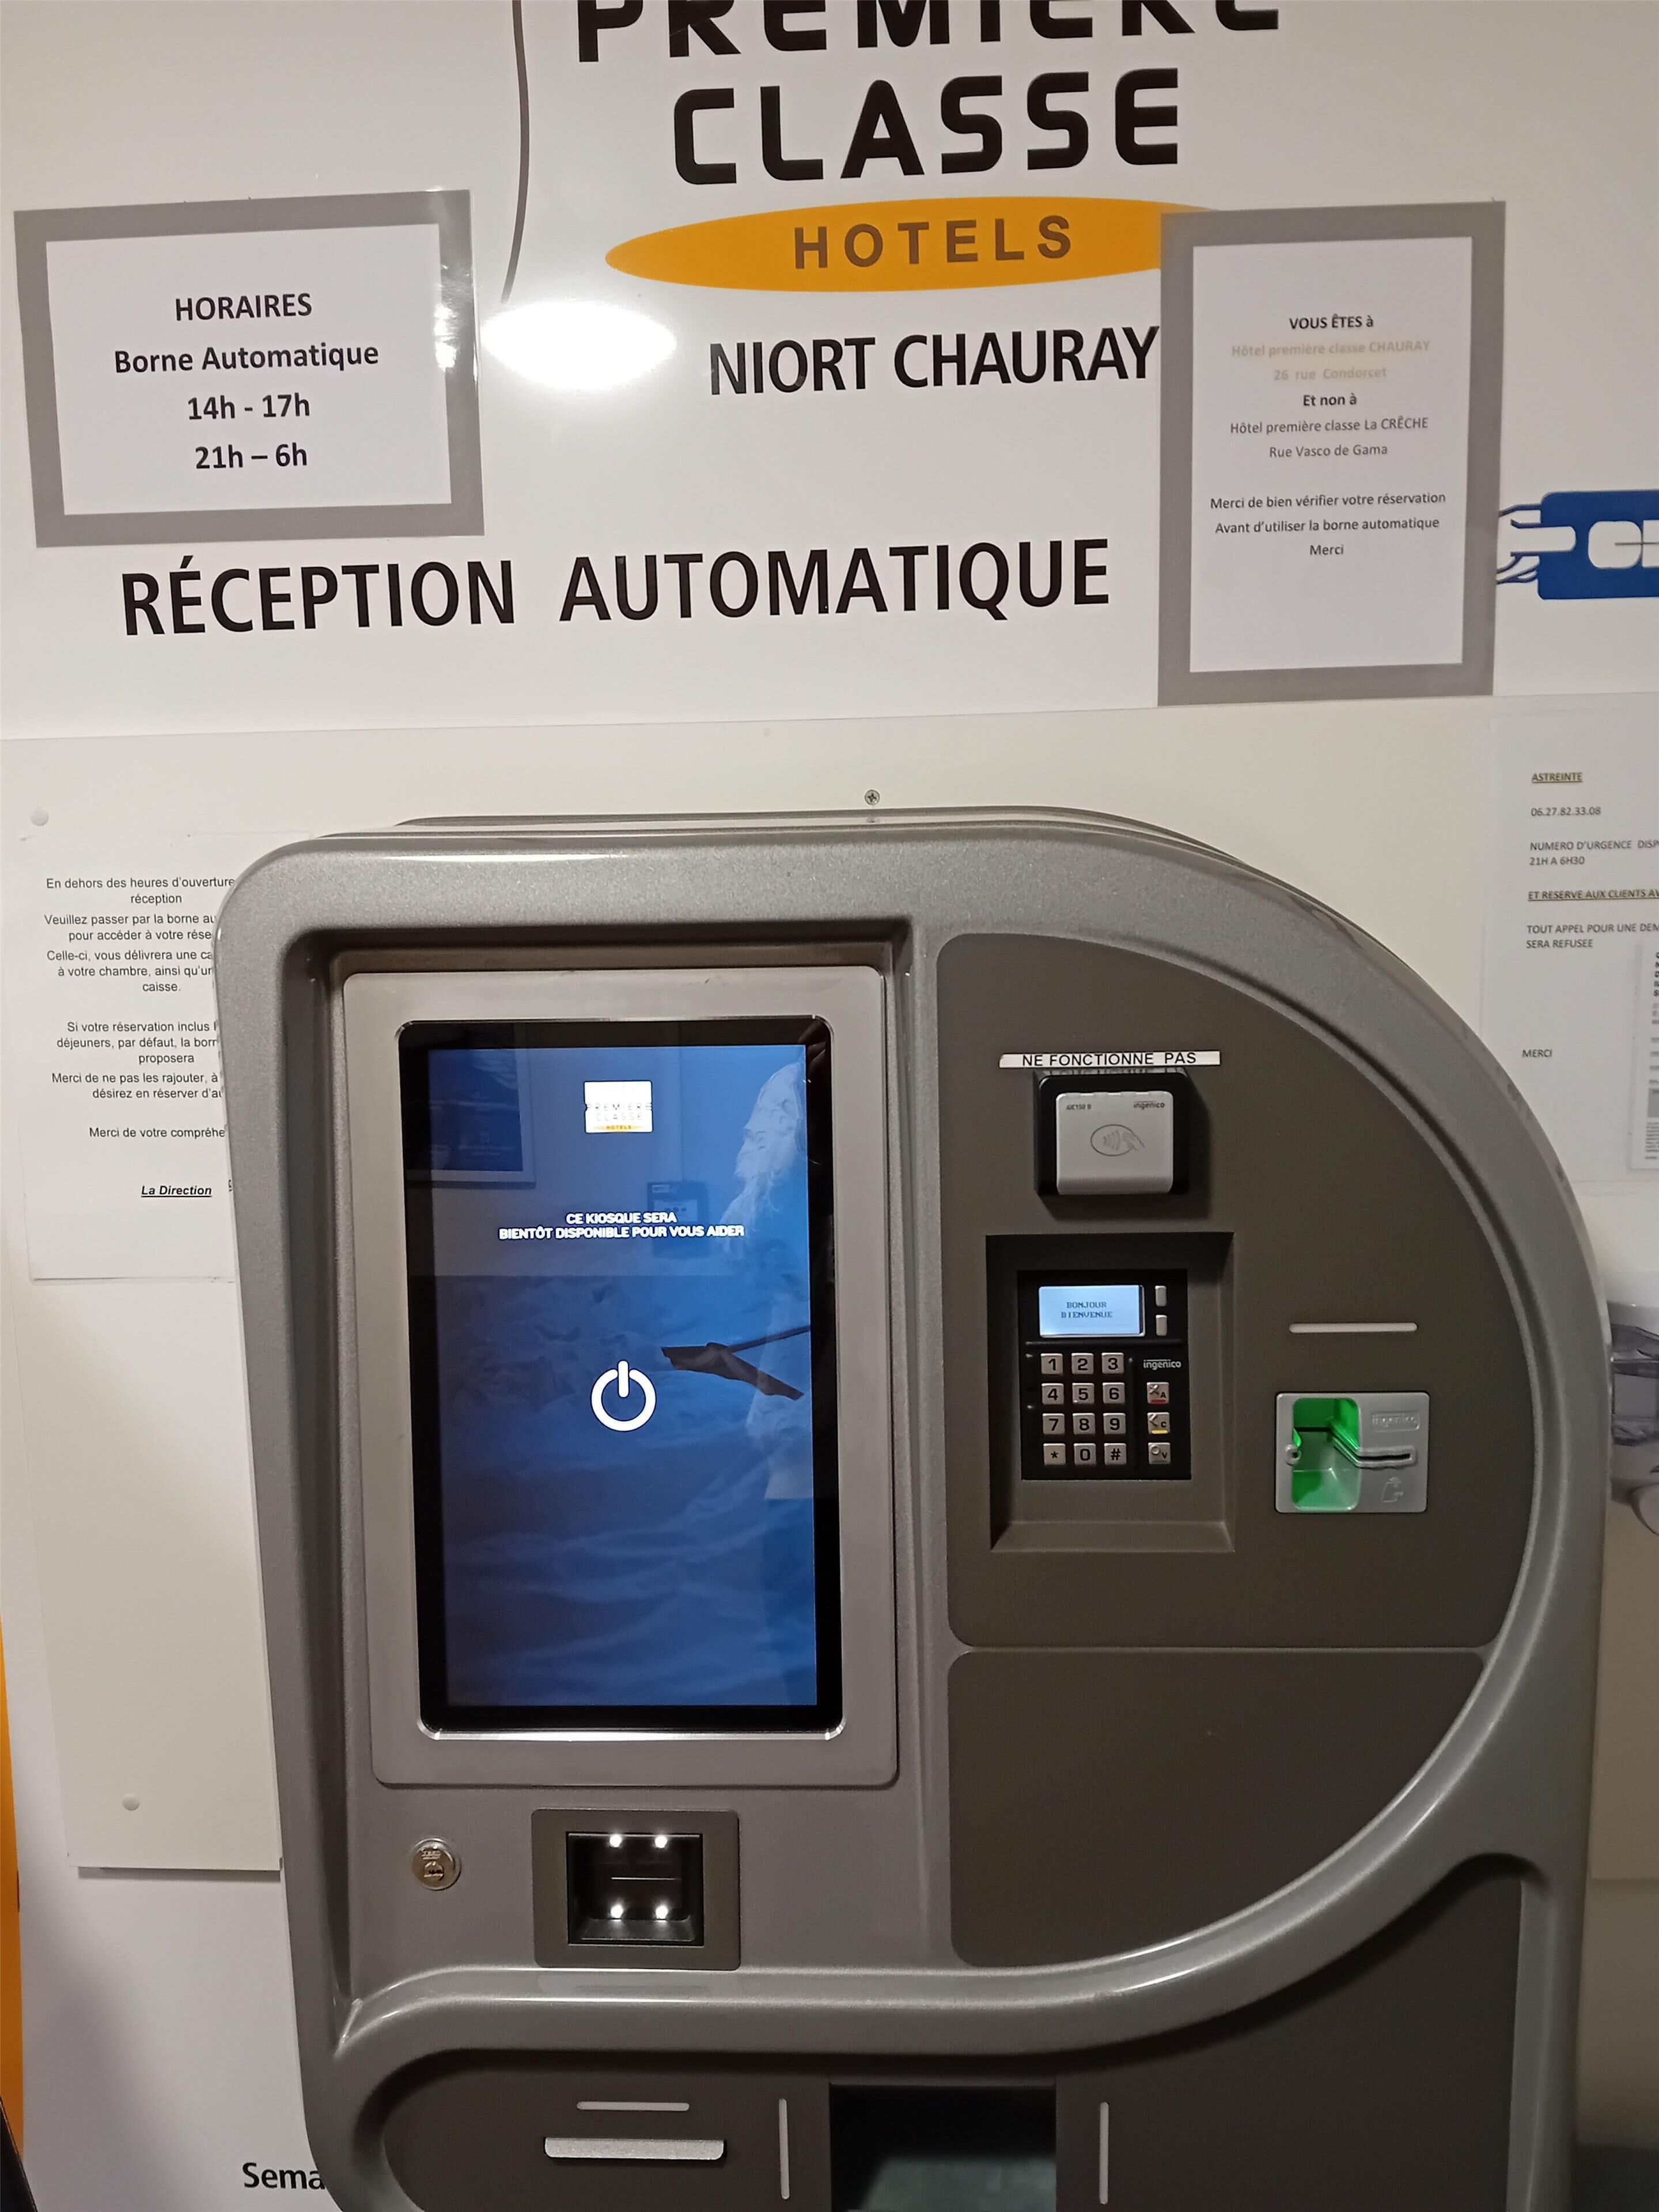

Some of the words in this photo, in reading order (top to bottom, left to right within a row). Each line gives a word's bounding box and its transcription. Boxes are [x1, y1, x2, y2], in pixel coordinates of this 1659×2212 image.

[674, 68, 1179, 184] CLASSE
[794, 215, 1071, 270] HOTELS
[176, 293, 312, 321] HORAIRES
[1289, 317, 1327, 330] VOUS
[1331, 314, 1362, 328] ÊTES
[1366, 315, 1374, 328] à
[1232, 344, 1265, 357] Hôtel
[1268, 343, 1325, 358] première
[1329, 342, 1365, 354] classe
[1369, 340, 1430, 353] CHAURAY
[115, 350, 193, 373] Borne
[202, 343, 379, 371] Automatique
[709, 337, 875, 396] NIORT
[894, 325, 1160, 388] CHAURAY
[1274, 369, 1288, 380] 26
[1296, 370, 1316, 380] rue
[1323, 368, 1387, 380] Condorcet
[1303, 395, 1316, 406] Et
[1320, 395, 1345, 405] non
[1349, 393, 1357, 404] à
[188, 396, 236, 421] 14h
[263, 393, 310, 418] 17h
[1230, 421, 1263, 434] Hôtel
[1267, 421, 1321, 435] première
[1325, 419, 1361, 430] classe
[1365, 419, 1377, 430] La
[1381, 416, 1428, 429] CRÊCHE
[195, 445, 243, 469] 21h
[275, 442, 308, 467] 6h
[1269, 446, 1292, 457] Rue
[1296, 446, 1331, 457] Vasco
[1334, 445, 1349, 456] de
[1353, 444, 1388, 456] Gama
[1210, 497, 1245, 509] Merci
[1248, 497, 1263, 508] de
[1267, 495, 1292, 507] bien
[1296, 494, 1338, 506] vérifier
[1342, 495, 1374, 505] votre
[1377, 492, 1446, 505] réservation
[1215, 522, 1249, 533] Avant
[1309, 520, 1320, 531] la
[1323, 519, 1358, 531] borne
[1362, 517, 1440, 531] automatique
[1310, 544, 1344, 556] Merci
[122, 555, 515, 636] RÉCEPTION
[560, 539, 1109, 622] AUTOMATIQUE
[1532, 772, 1582, 783] ASTREINTE
[1531, 807, 1601, 816] 06.27.82.33.08
[1530, 842, 1574, 851] NUMERO
[1529, 857, 1547, 865] 21H
[1560, 856, 1585, 865] 6H30
[47, 878, 61, 889] En
[65, 878, 103, 888] dehors
[107, 878, 126, 888] des
[131, 878, 168, 888] heures
[131, 893, 182, 905] réception
[1528, 892, 1539, 901] ET
[1542, 891, 1582, 901] RESERVE
[1585, 891, 1605, 900] AUX
[1608, 889, 1646, 899] CLIENTS
[44, 915, 88, 925] Veuillez
[91, 915, 128, 926] passer
[132, 915, 150, 926] par
[154, 914, 164, 923] la
[167, 914, 199, 923] borne
[1527, 925, 1552, 934] TOUT
[1555, 925, 1584, 933] APPEL
[1587, 925, 1614, 933] POUR
[1618, 923, 1637, 932] UNE
[69, 931, 93, 942] pour
[97, 929, 141, 940] accéder
[145, 929, 152, 940] à
[156, 930, 183, 940] votre
[1527, 940, 1550, 949] SERA
[1553, 939, 1593, 948] REFUSEE
[47, 950, 90, 961] Celle-ci,
[94, 951, 120, 960] vous
[124, 949, 173, 960] délivrera
[176, 951, 197, 960] une
[58, 967, 65, 976] à
[68, 967, 95, 976] votre
[99, 966, 151, 977] chambre,
[155, 965, 180, 976] ainsi
[143, 982, 181, 991] caisse.
[67, 1022, 78, 1032] Si
[82, 1022, 109, 1032] votre
[113, 1022, 174, 1032] réservation
[178, 1021, 210, 1032] inclus
[57, 1038, 114, 1049] déjeuners,
[118, 1039, 135, 1048] par
[139, 1037, 177, 1047] défaut,
[181, 1037, 190, 1047] la
[1023, 1055, 1043, 1066] NE
[1050, 1053, 1153, 1066] FONCTIONNE
[1165, 1052, 1196, 1063] PAS
[1522, 1049, 1552, 1058] MERCI
[139, 1055, 194, 1065] proposera
[52, 1073, 82, 1083] Merci
[85, 1073, 99, 1082] de
[103, 1074, 116, 1082] ne
[120, 1073, 139, 1084] pas
[143, 1073, 158, 1082] les
[162, 1073, 207, 1084] rajouter,
[211, 1073, 218, 1082] à
[93, 1088, 132, 1099] désirez
[136, 1089, 149, 1098] en
[153, 1088, 198, 1099] réserver
[1134, 1101, 1165, 1110] ingenico
[89, 1127, 119, 1137] Merci
[123, 1127, 137, 1137] de
[140, 1128, 167, 1137] votre
[141, 1185, 156, 1195] La
[159, 1185, 212, 1196] Direction
[566, 1214, 583, 1224] CE
[586, 1213, 641, 1224] KIOSQUE
[643, 1212, 677, 1223] SERA
[499, 1225, 553, 1240] BIENTÔT
[556, 1227, 630, 1239] DISPONIBLE
[632, 1227, 666, 1237] POUR
[669, 1226, 704, 1237] VOUS
[706, 1225, 744, 1236] AIDER
[1048, 1359, 1056, 1370] 1
[1077, 1359, 1088, 1370] 2
[1108, 1358, 1118, 1370] 3
[1143, 1359, 1181, 1370] ingenico
[1047, 1389, 1058, 1400] 4
[1078, 1388, 1088, 1400] 5
[1109, 1388, 1119, 1400] 6
[1049, 1419, 1059, 1430] 7
[1079, 1418, 1089, 1430] 8
[1109, 1418, 1120, 1430] 9
[1080, 1449, 1090, 1461] 0
